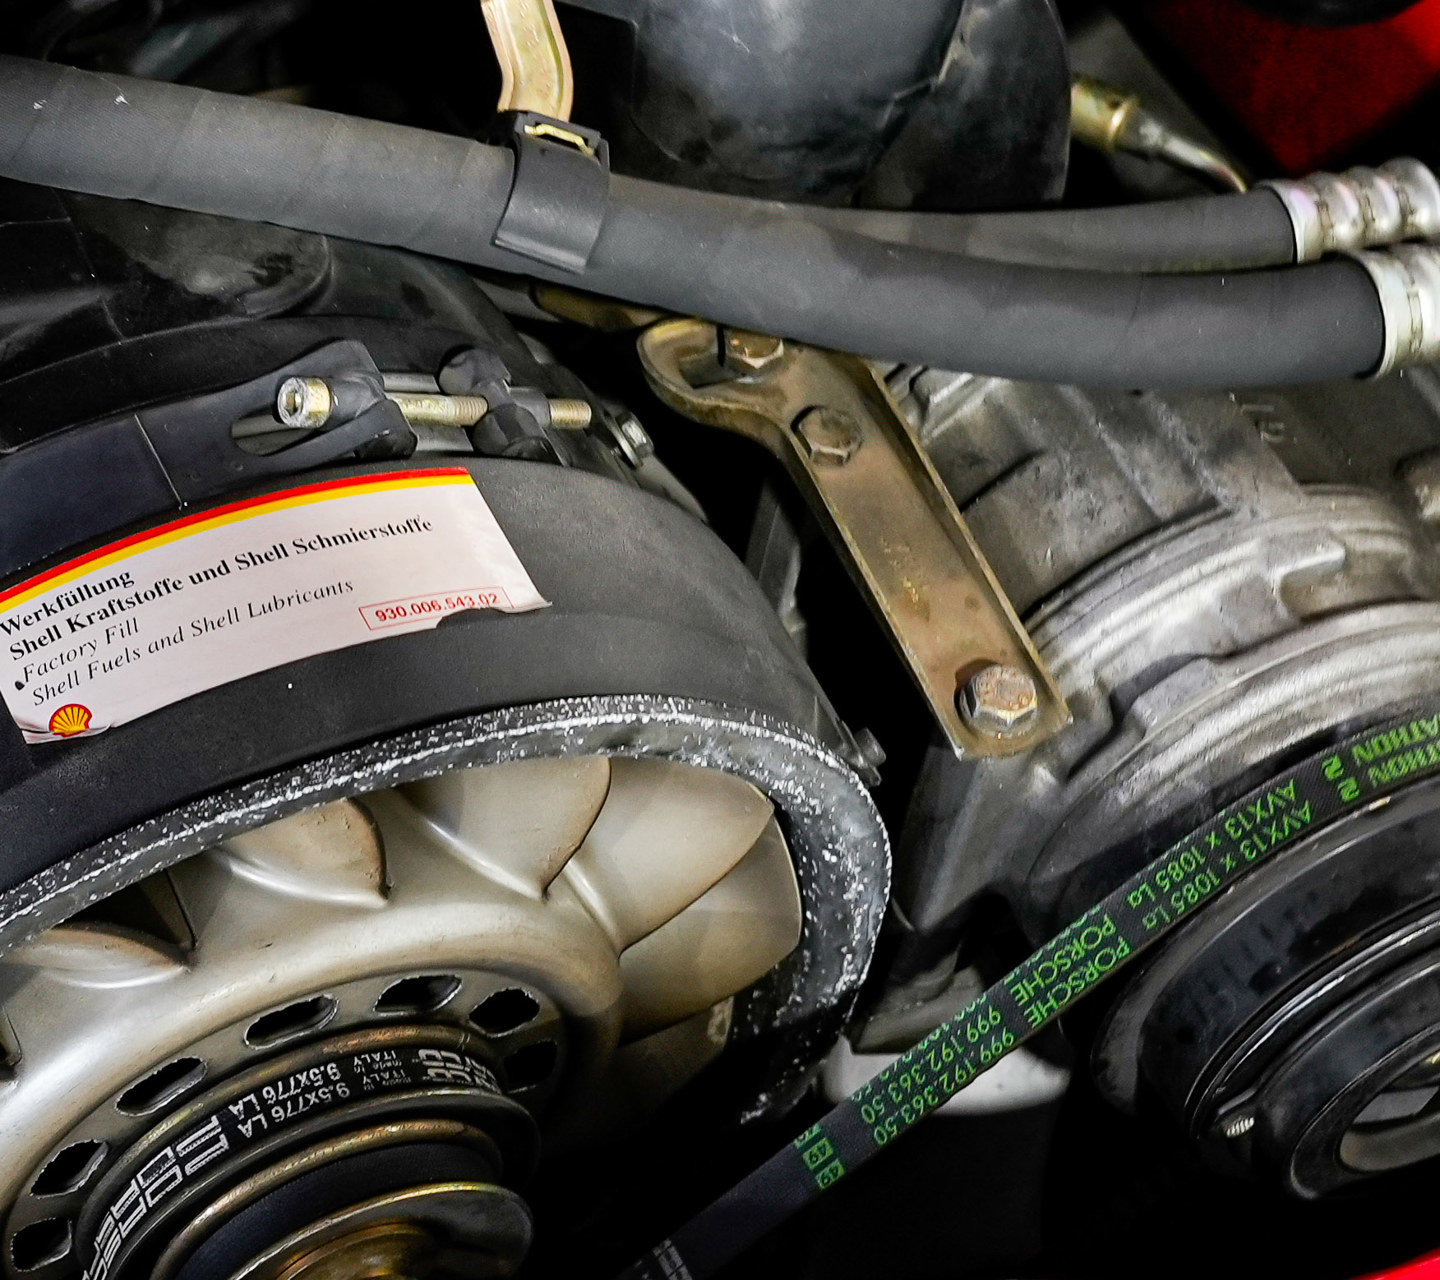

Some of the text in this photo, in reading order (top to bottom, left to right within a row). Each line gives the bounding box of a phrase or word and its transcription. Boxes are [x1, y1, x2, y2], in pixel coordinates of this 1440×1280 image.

[10, 515, 433, 662] Shell Kraftstoffe und Shell Schmierstoffe
[375, 592, 499, 622] 930.006.543.02
[22, 618, 140, 683] Factory Fill
[33, 579, 354, 707] Shell Fuels and Shell Lubricants
[1322, 755, 1345, 780] 2
[1225, 779, 1298, 834] AVX13
[1338, 779, 1359, 803] 2
[1241, 801, 1313, 859] AVX13
[1157, 848, 1207, 892] 1085
[1171, 869, 1221, 913] 1085
[1014, 913, 1118, 1008] PORSCHE
[1022, 935, 1132, 1029] PORSCHE
[351, 1049, 396, 1066] ITALY
[860, 1004, 1002, 1124] 999.192.363.50
[228, 1093, 258, 1117] LA
[262, 1061, 343, 1106] 9.5x776
[270, 1083, 351, 1123] 9.5x776
[873, 1025, 1016, 1147] 999.192.363.50
[237, 1110, 269, 1138] LA
